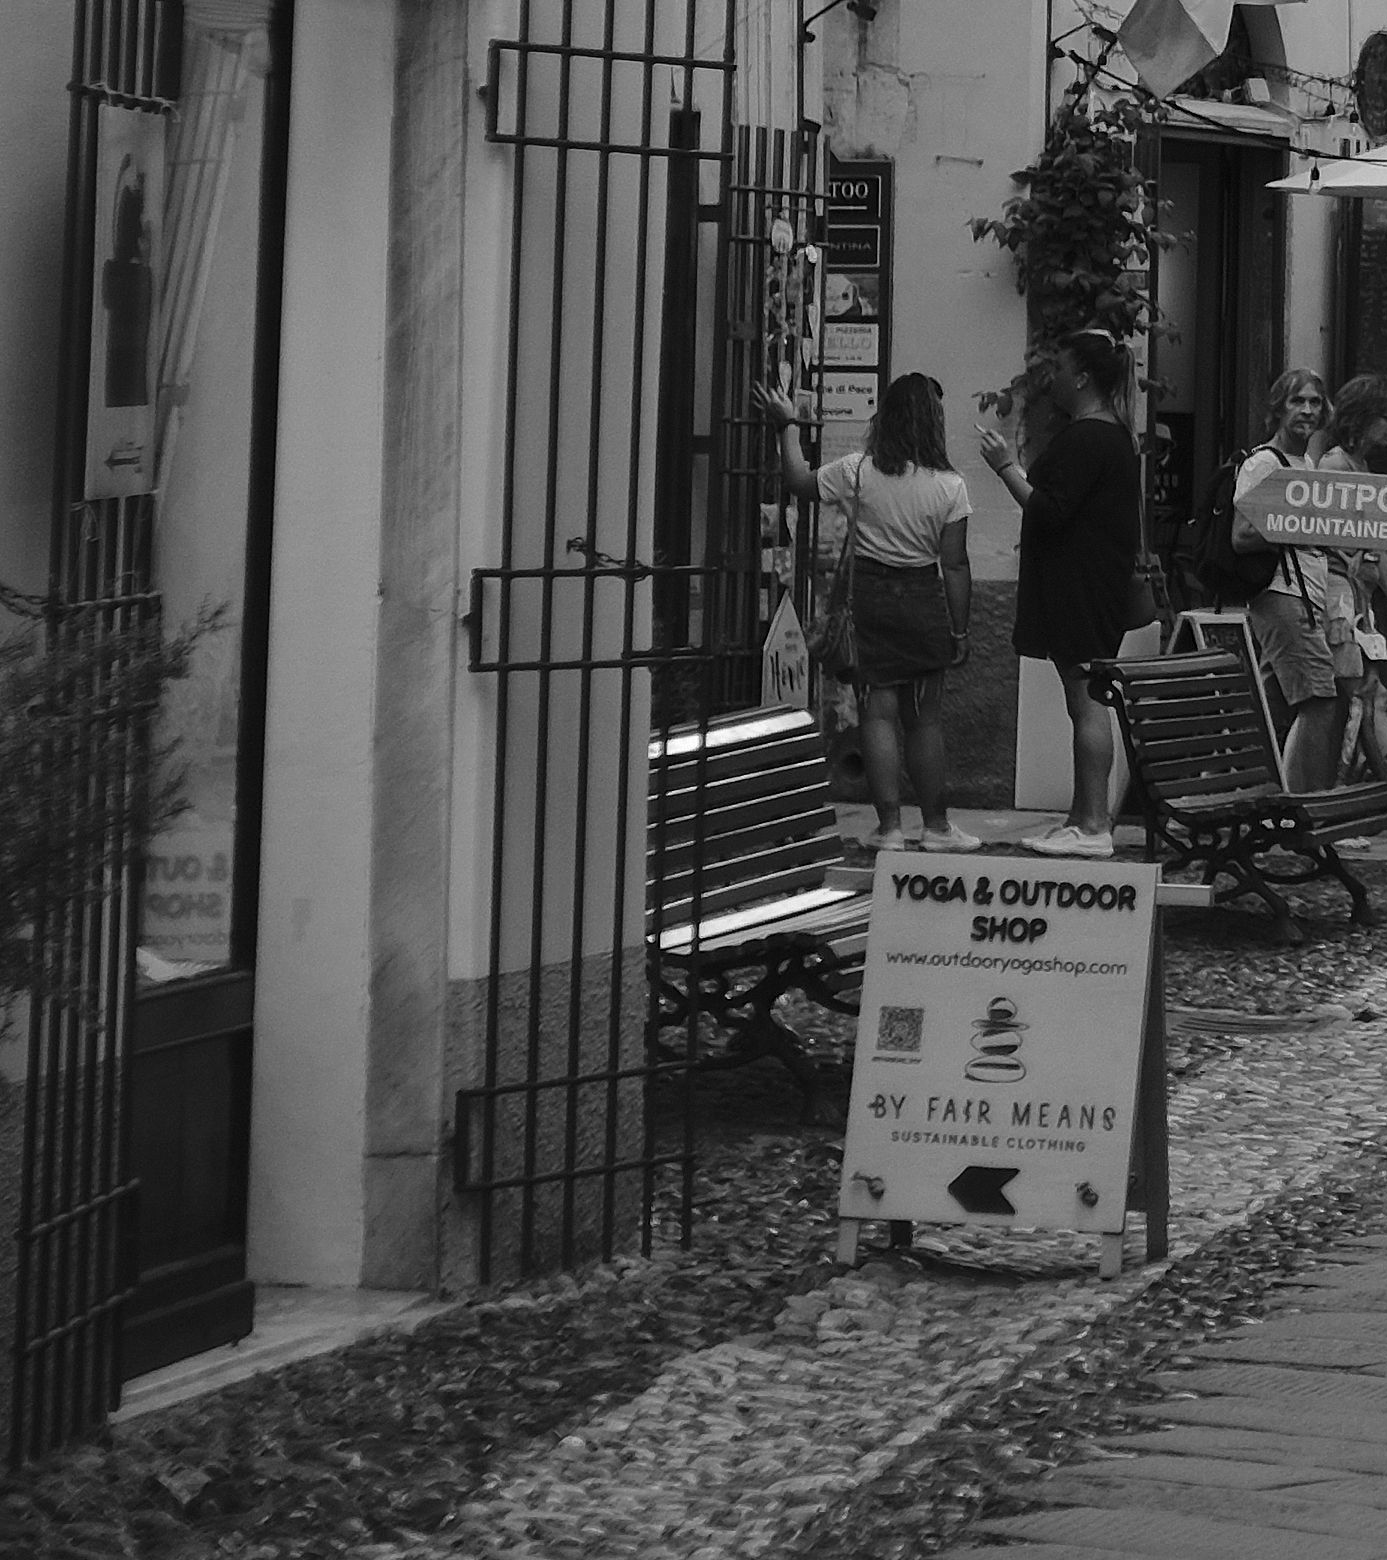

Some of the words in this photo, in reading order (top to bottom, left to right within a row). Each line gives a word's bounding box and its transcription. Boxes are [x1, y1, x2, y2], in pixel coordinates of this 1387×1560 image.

[892, 874, 967, 903] YOGA
[973, 876, 994, 906] &
[1000, 879, 1137, 911] OUTDOOR
[970, 915, 1048, 944] SHOP
[886, 951, 1128, 976] www.outdooryogashop.com
[868, 1093, 907, 1120] BY
[927, 1097, 992, 1125] FAIR
[1012, 1101, 1117, 1131] MEANS
[891, 1130, 1000, 1149] SUSTAINABLE
[1007, 1136, 1087, 1154] CLOTHING
